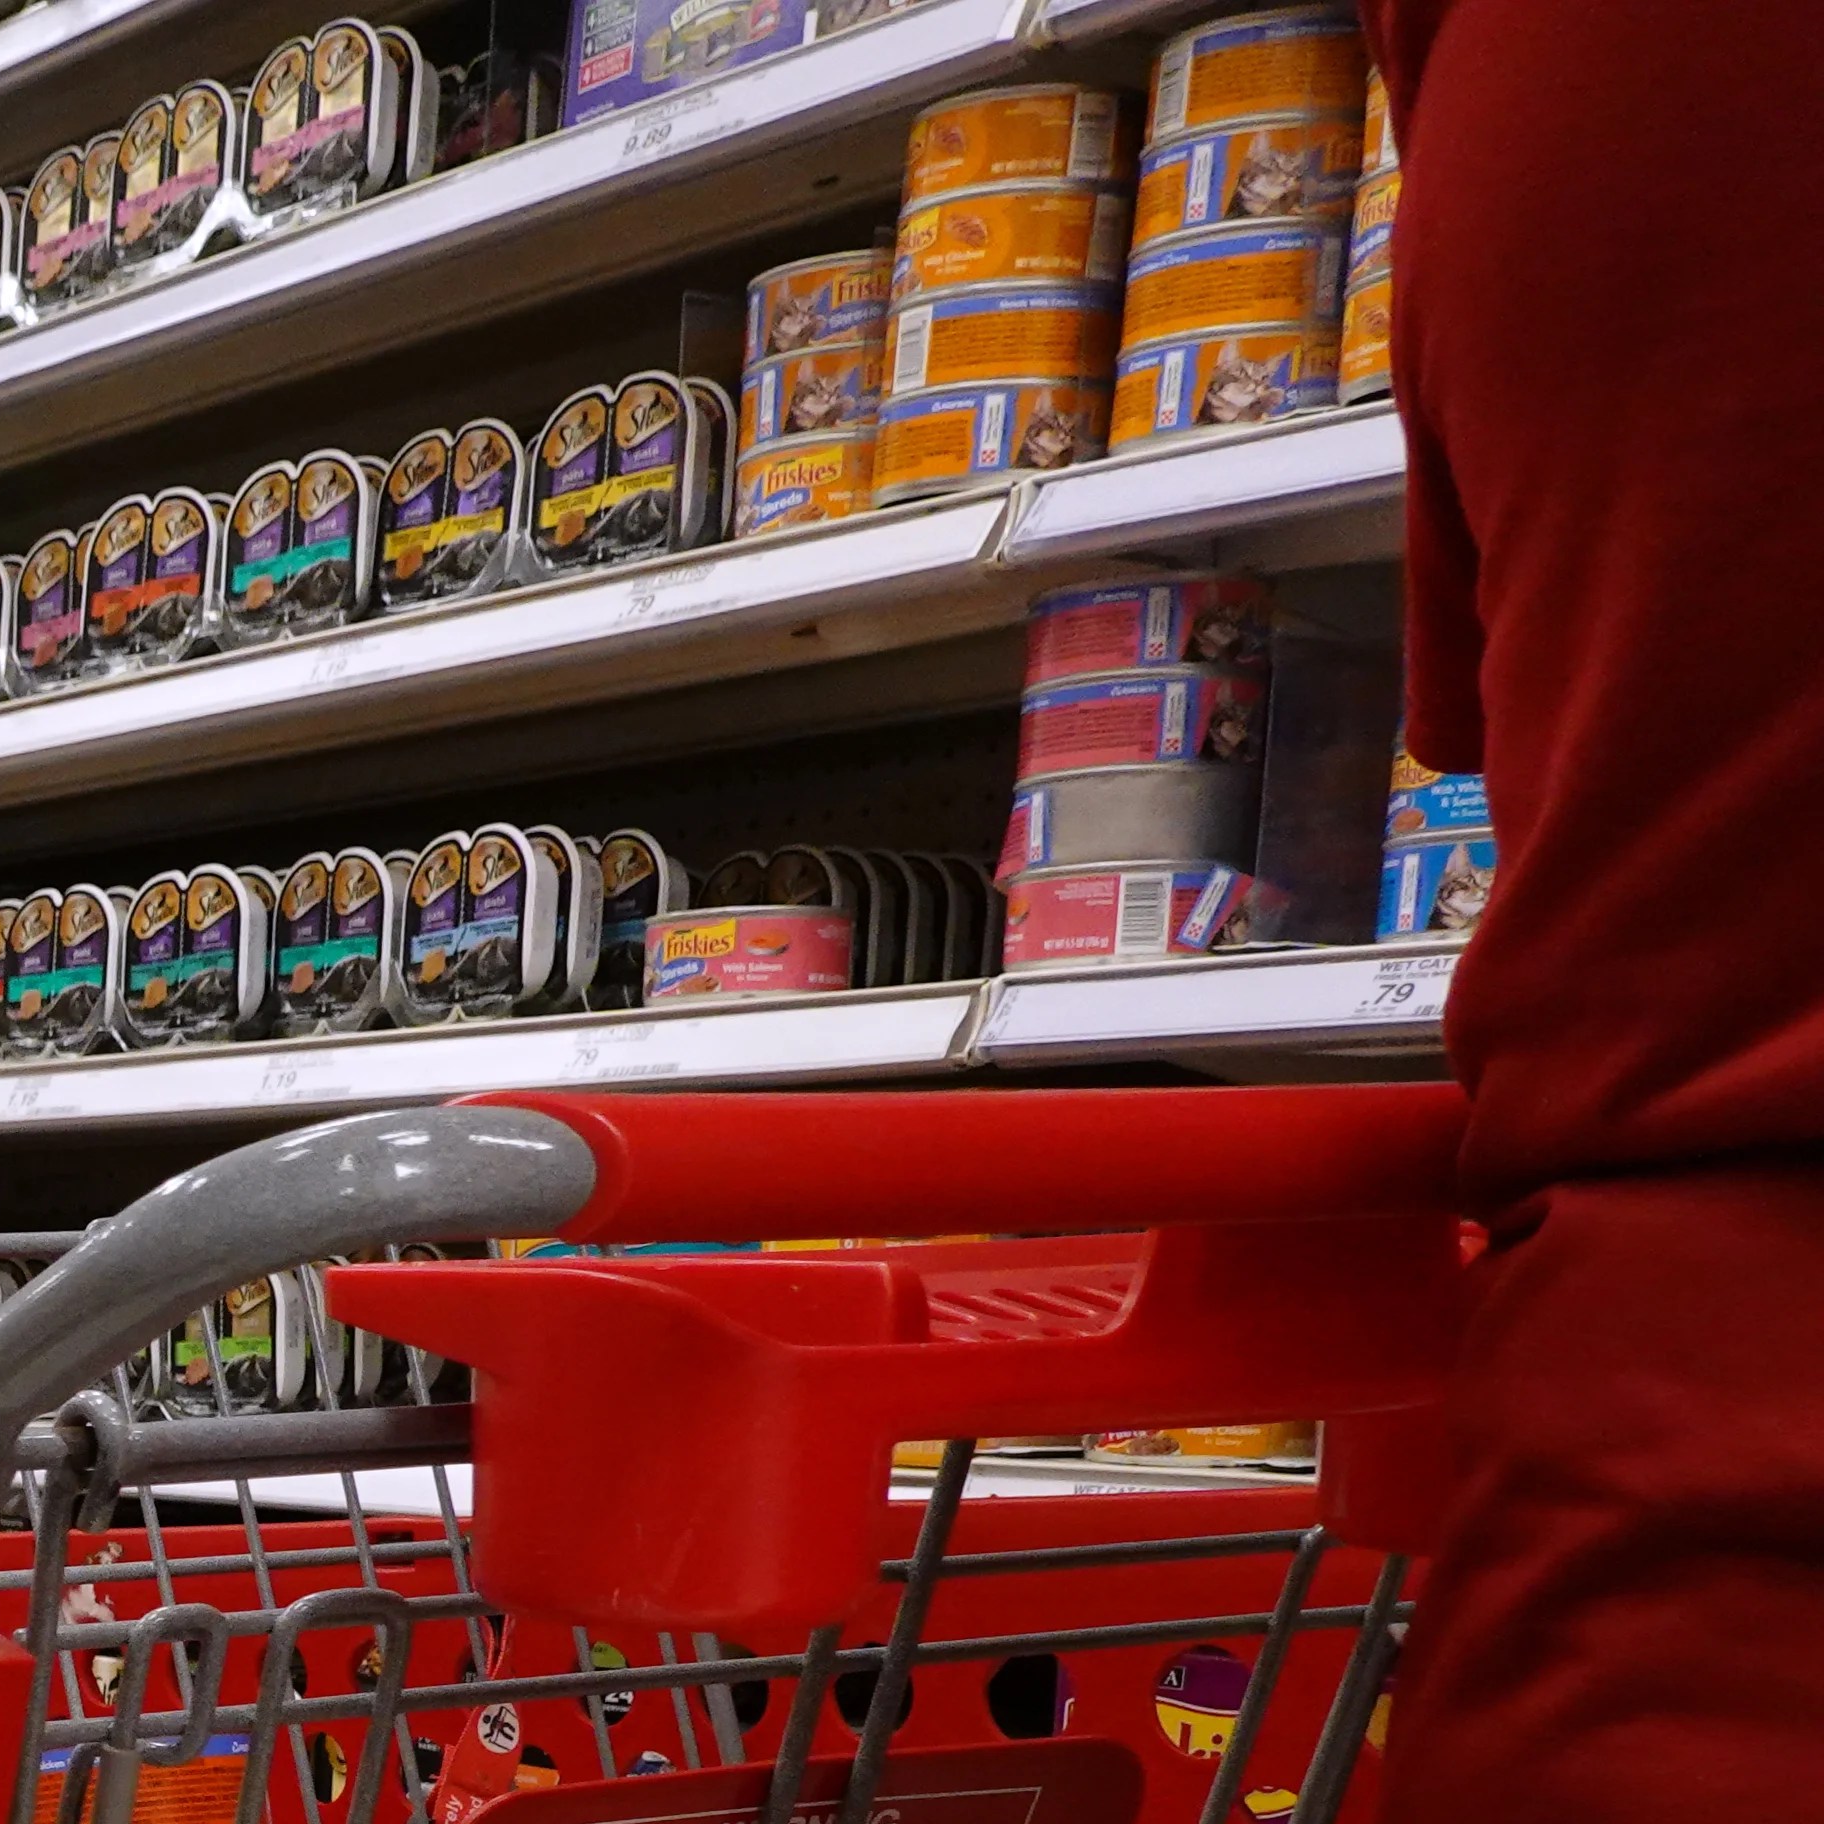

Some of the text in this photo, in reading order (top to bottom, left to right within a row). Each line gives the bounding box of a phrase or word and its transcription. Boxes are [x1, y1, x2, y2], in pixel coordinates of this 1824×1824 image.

[622, 124, 673, 156] 9.89
[666, 933, 732, 956] Friskies
[1379, 957, 1452, 974] WET CAT
[1360, 982, 1416, 1006] .79
[563, 1047, 599, 1068] .79
[259, 1070, 297, 1089] 1.19
